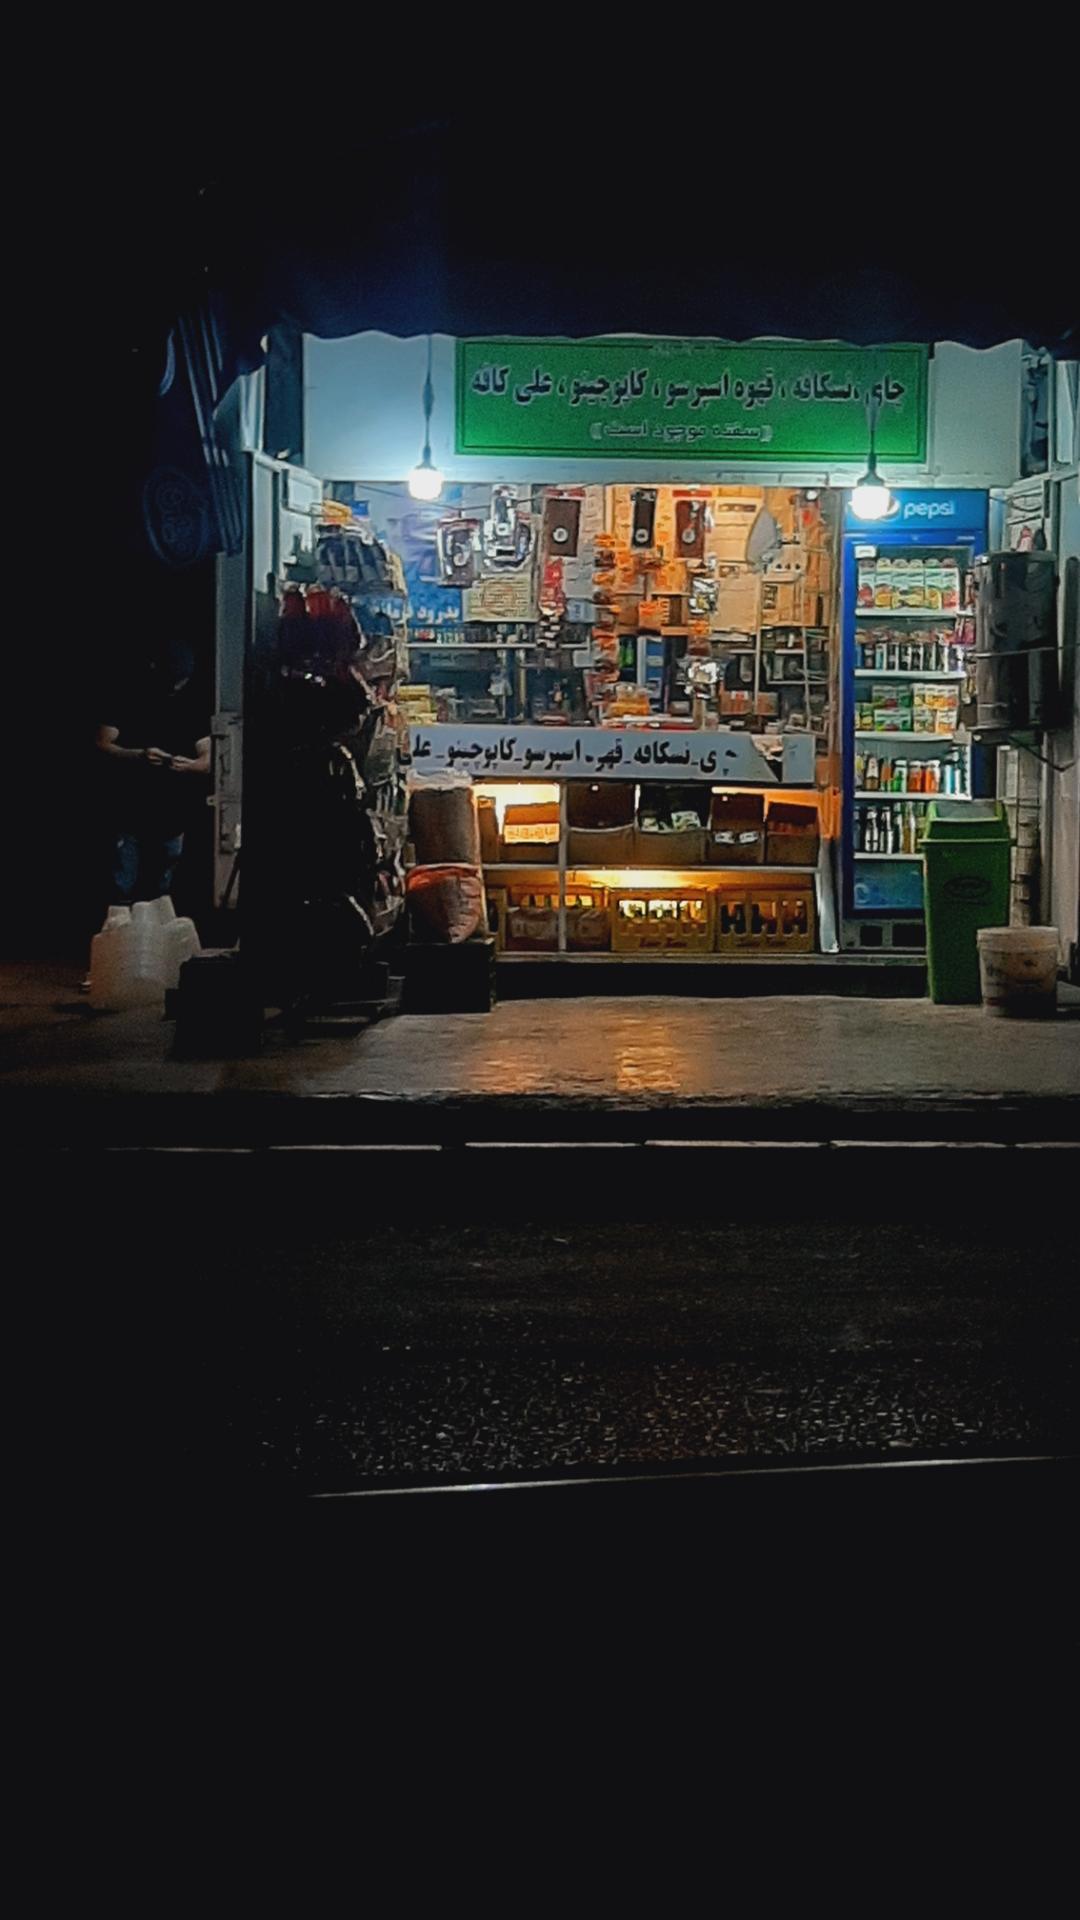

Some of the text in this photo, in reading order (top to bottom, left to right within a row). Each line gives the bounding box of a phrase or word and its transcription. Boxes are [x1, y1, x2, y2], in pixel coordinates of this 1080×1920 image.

[471, 363, 509, 393] کافه
[515, 369, 551, 403] علی
[903, 501, 956, 520] pepsi
